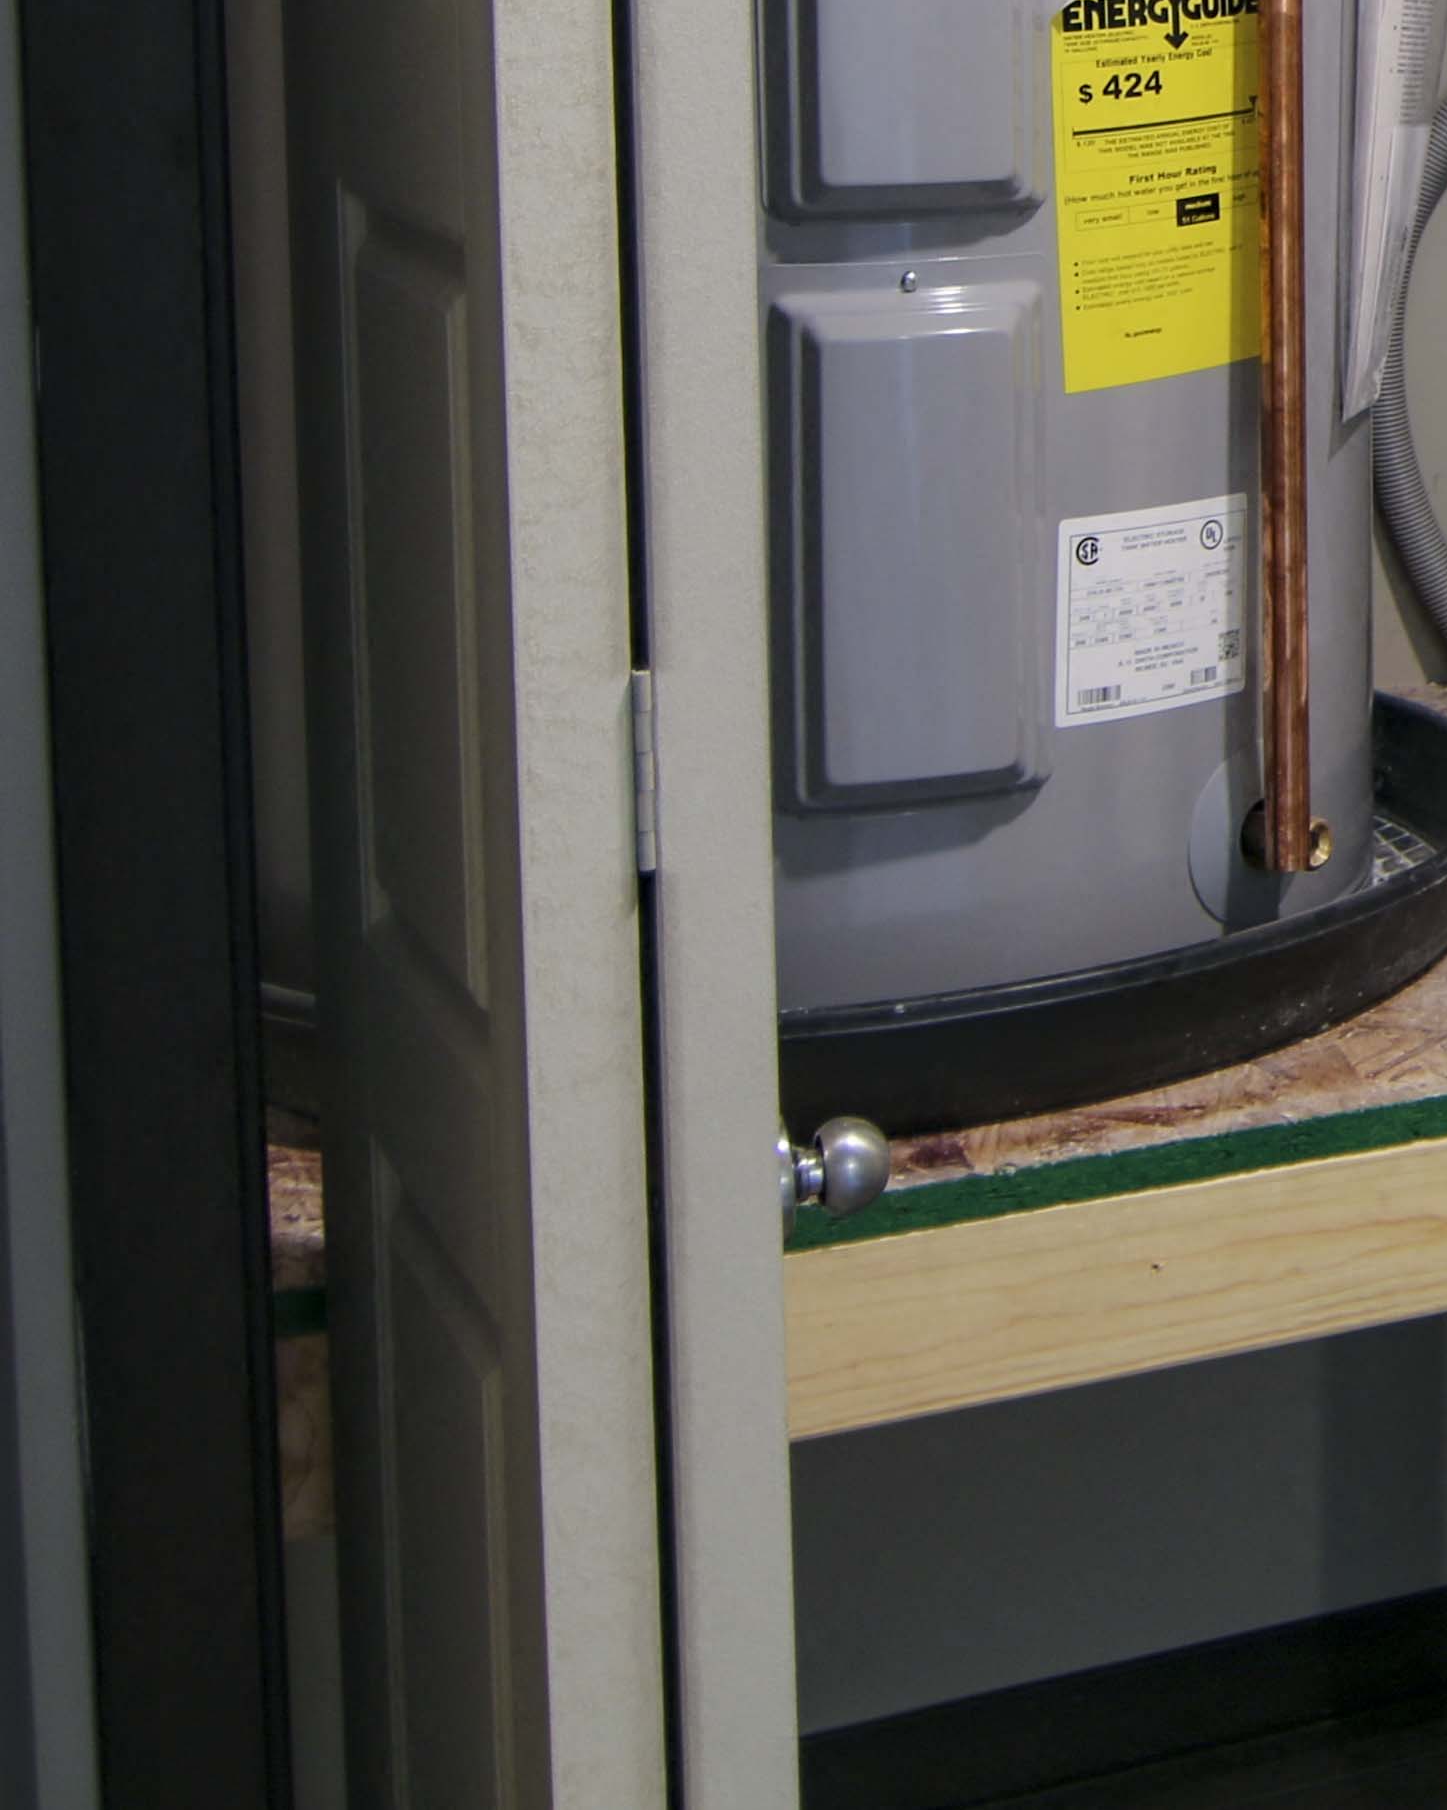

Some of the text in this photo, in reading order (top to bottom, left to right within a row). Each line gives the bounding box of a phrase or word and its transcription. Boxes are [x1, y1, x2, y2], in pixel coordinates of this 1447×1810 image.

[1096, 48, 1212, 68] Estimated Yearly Energy Cost
[1078, 70, 1162, 104] $ 424
[1129, 164, 1217, 184] First Hour Rating
[1091, 191, 1115, 202] much
[1133, 186, 1157, 196] water
[1159, 184, 1173, 195] you
[1176, 182, 1188, 192] get
[1198, 178, 1209, 186] the
